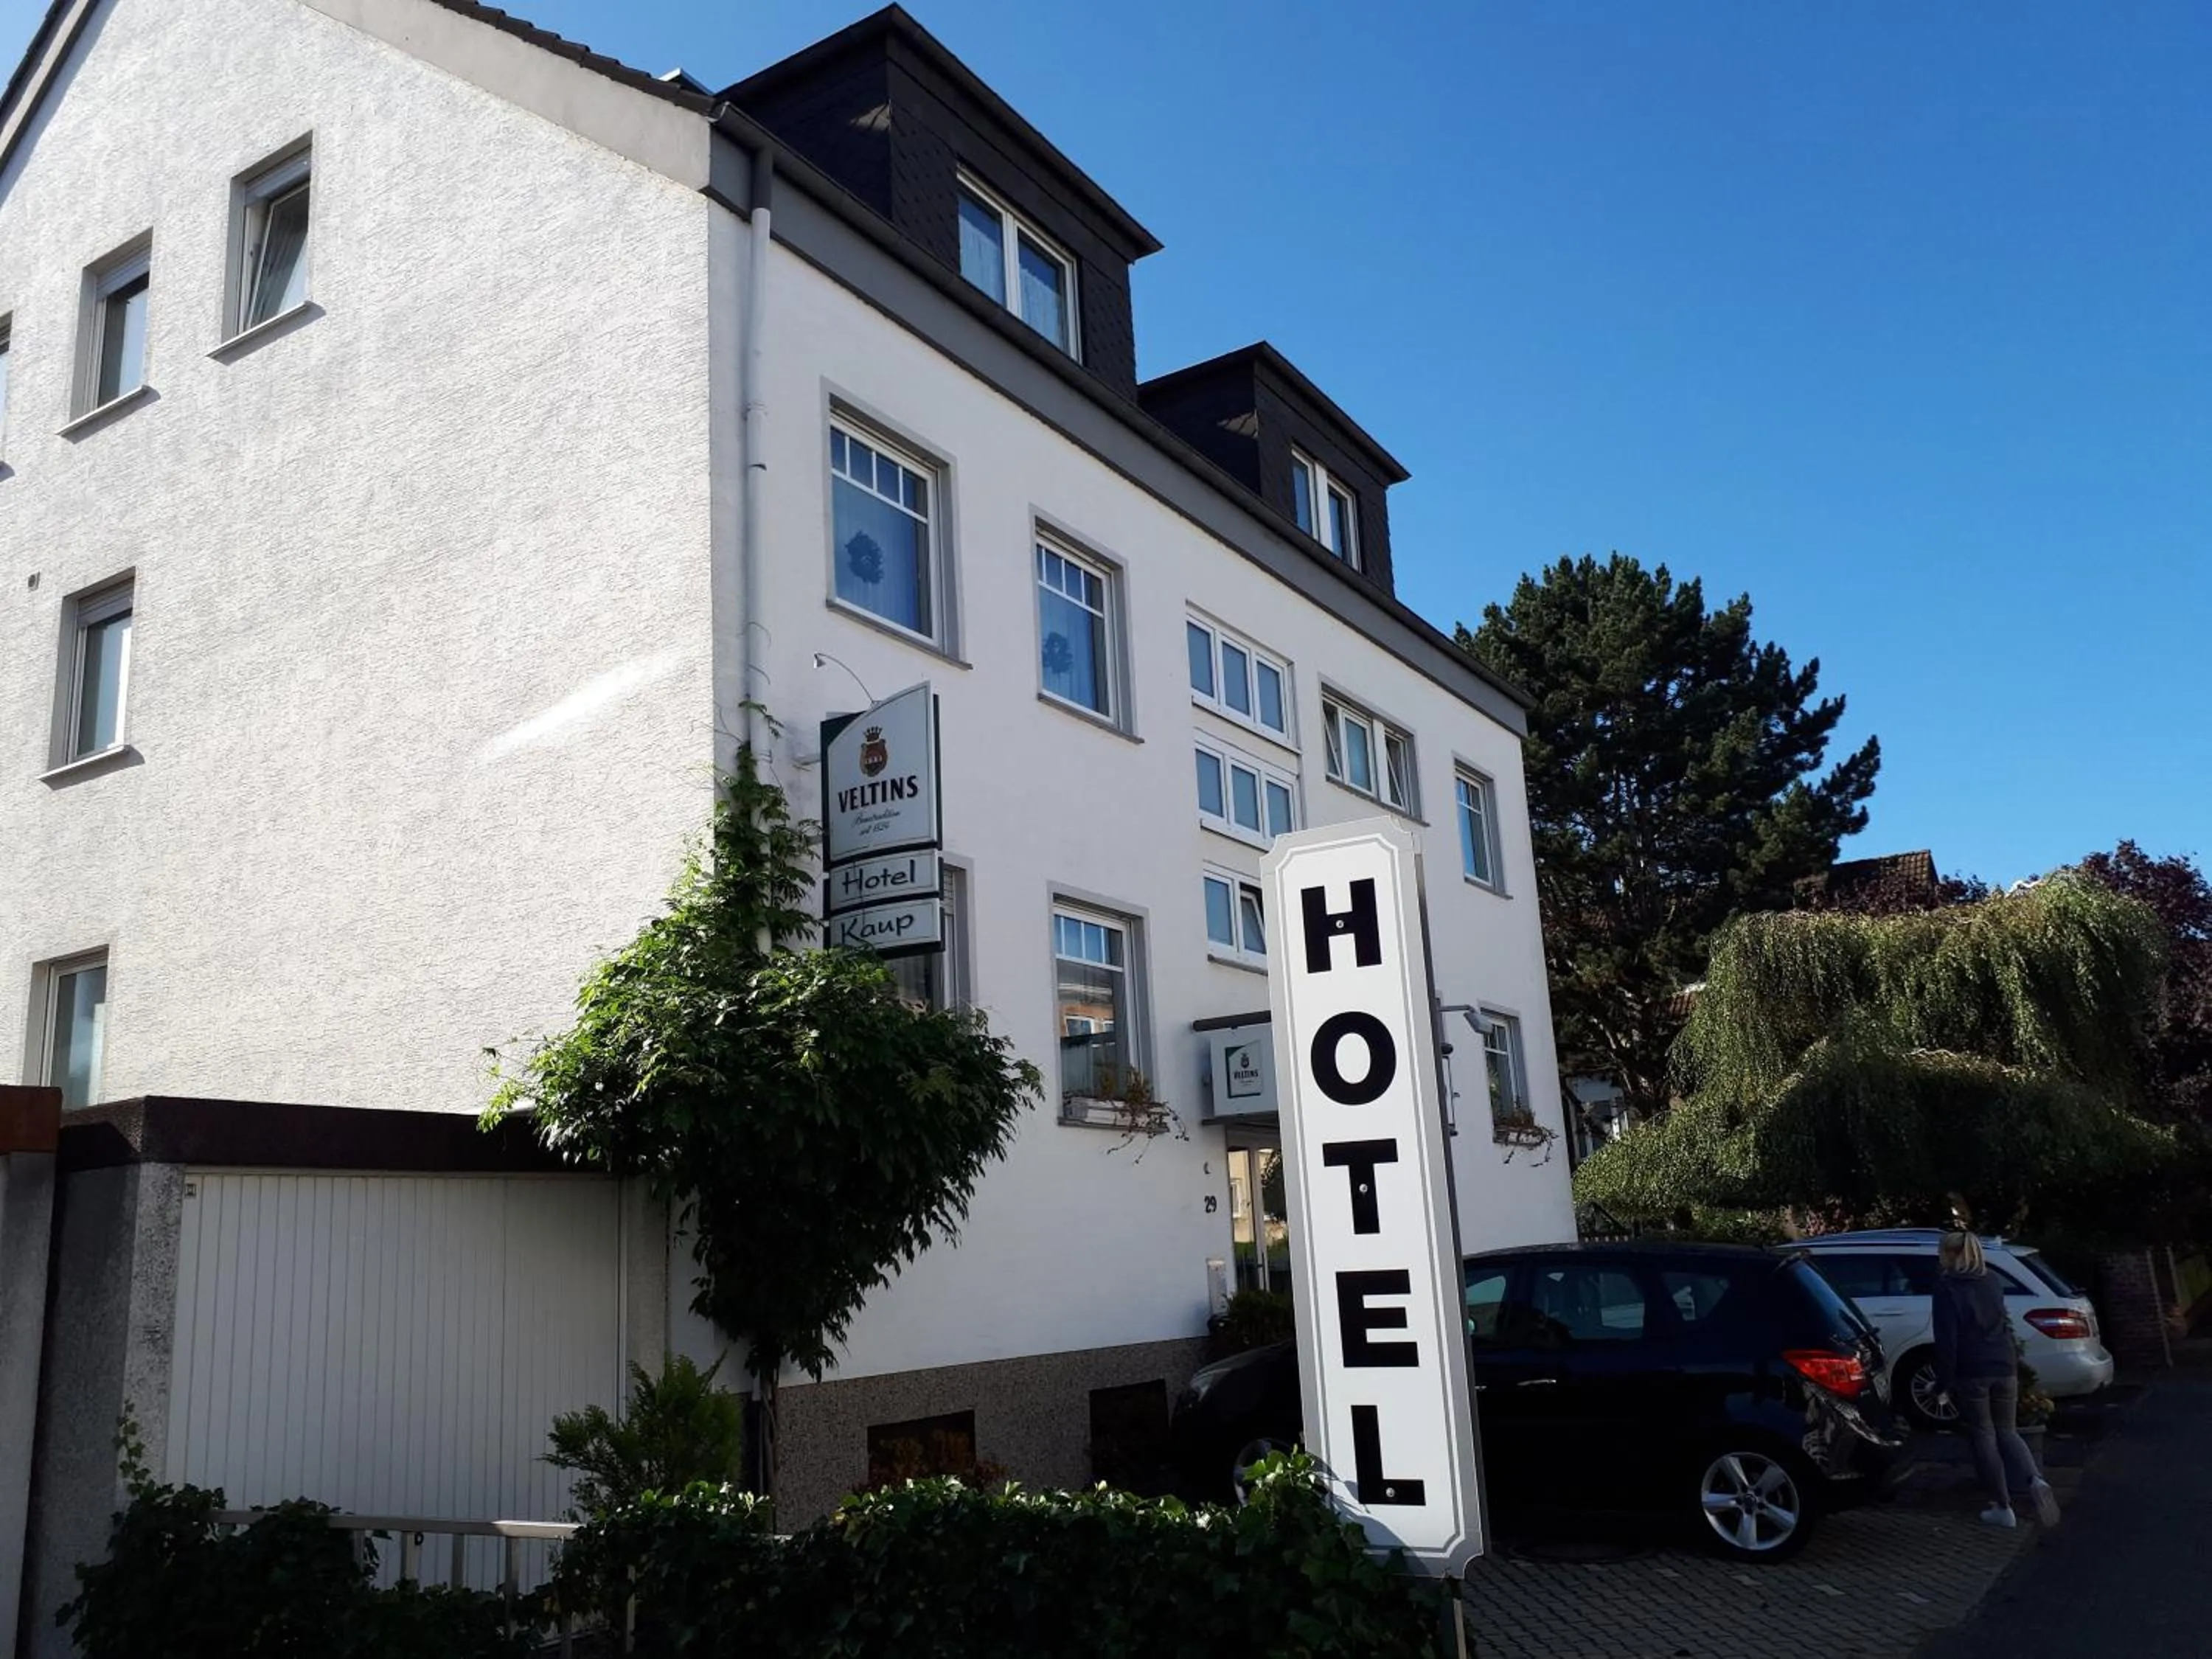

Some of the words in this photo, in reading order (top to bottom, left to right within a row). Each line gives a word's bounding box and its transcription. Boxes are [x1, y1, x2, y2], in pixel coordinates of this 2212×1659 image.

[838, 775, 918, 813] VELTINS
[843, 860, 915, 894] Hotel
[841, 914, 914, 945] Kaup
[1204, 1195, 1217, 1214] 29
[1301, 877, 1426, 1506] HOTEL
